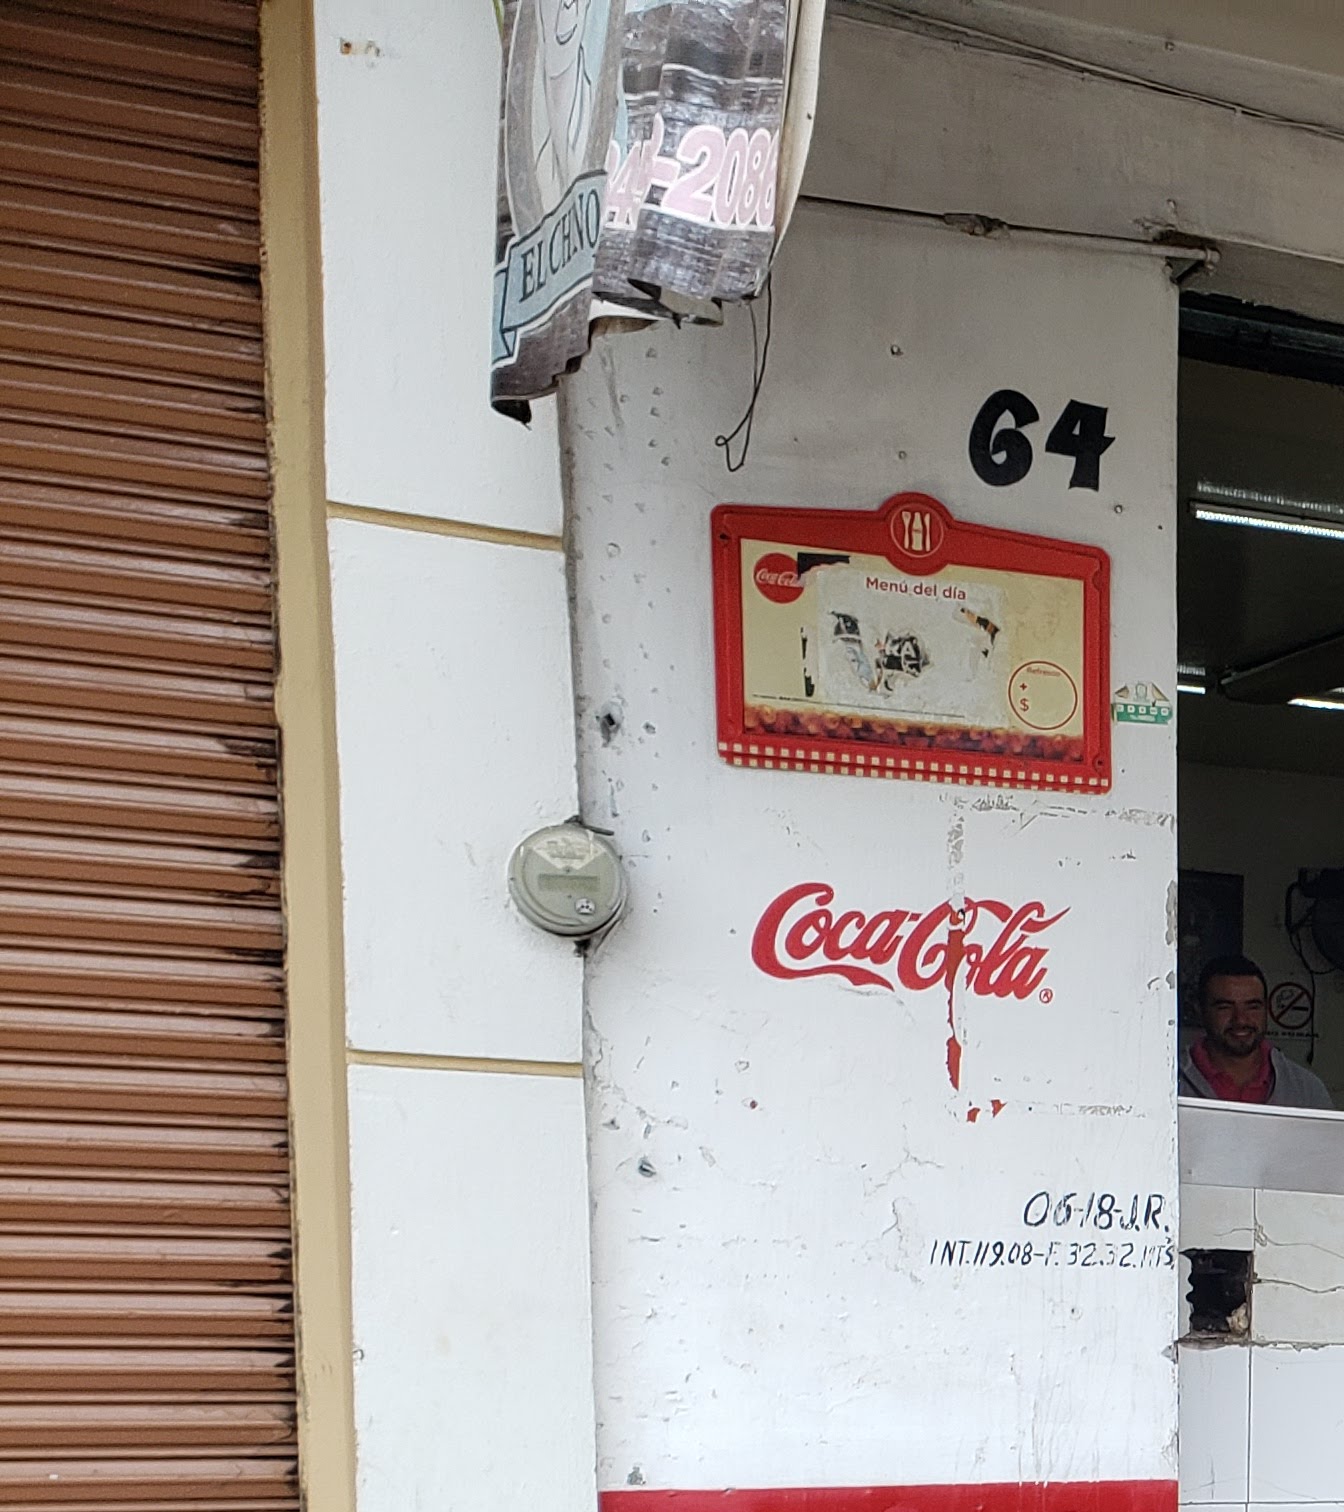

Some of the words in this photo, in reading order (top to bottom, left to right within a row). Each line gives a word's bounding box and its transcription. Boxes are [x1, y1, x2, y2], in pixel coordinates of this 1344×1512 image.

[968, 389, 1116, 491] 64
[866, 576, 908, 592] Menú
[913, 581, 937, 597] del
[943, 585, 967, 600] día
[751, 882, 1072, 1000] Coca-Cola
